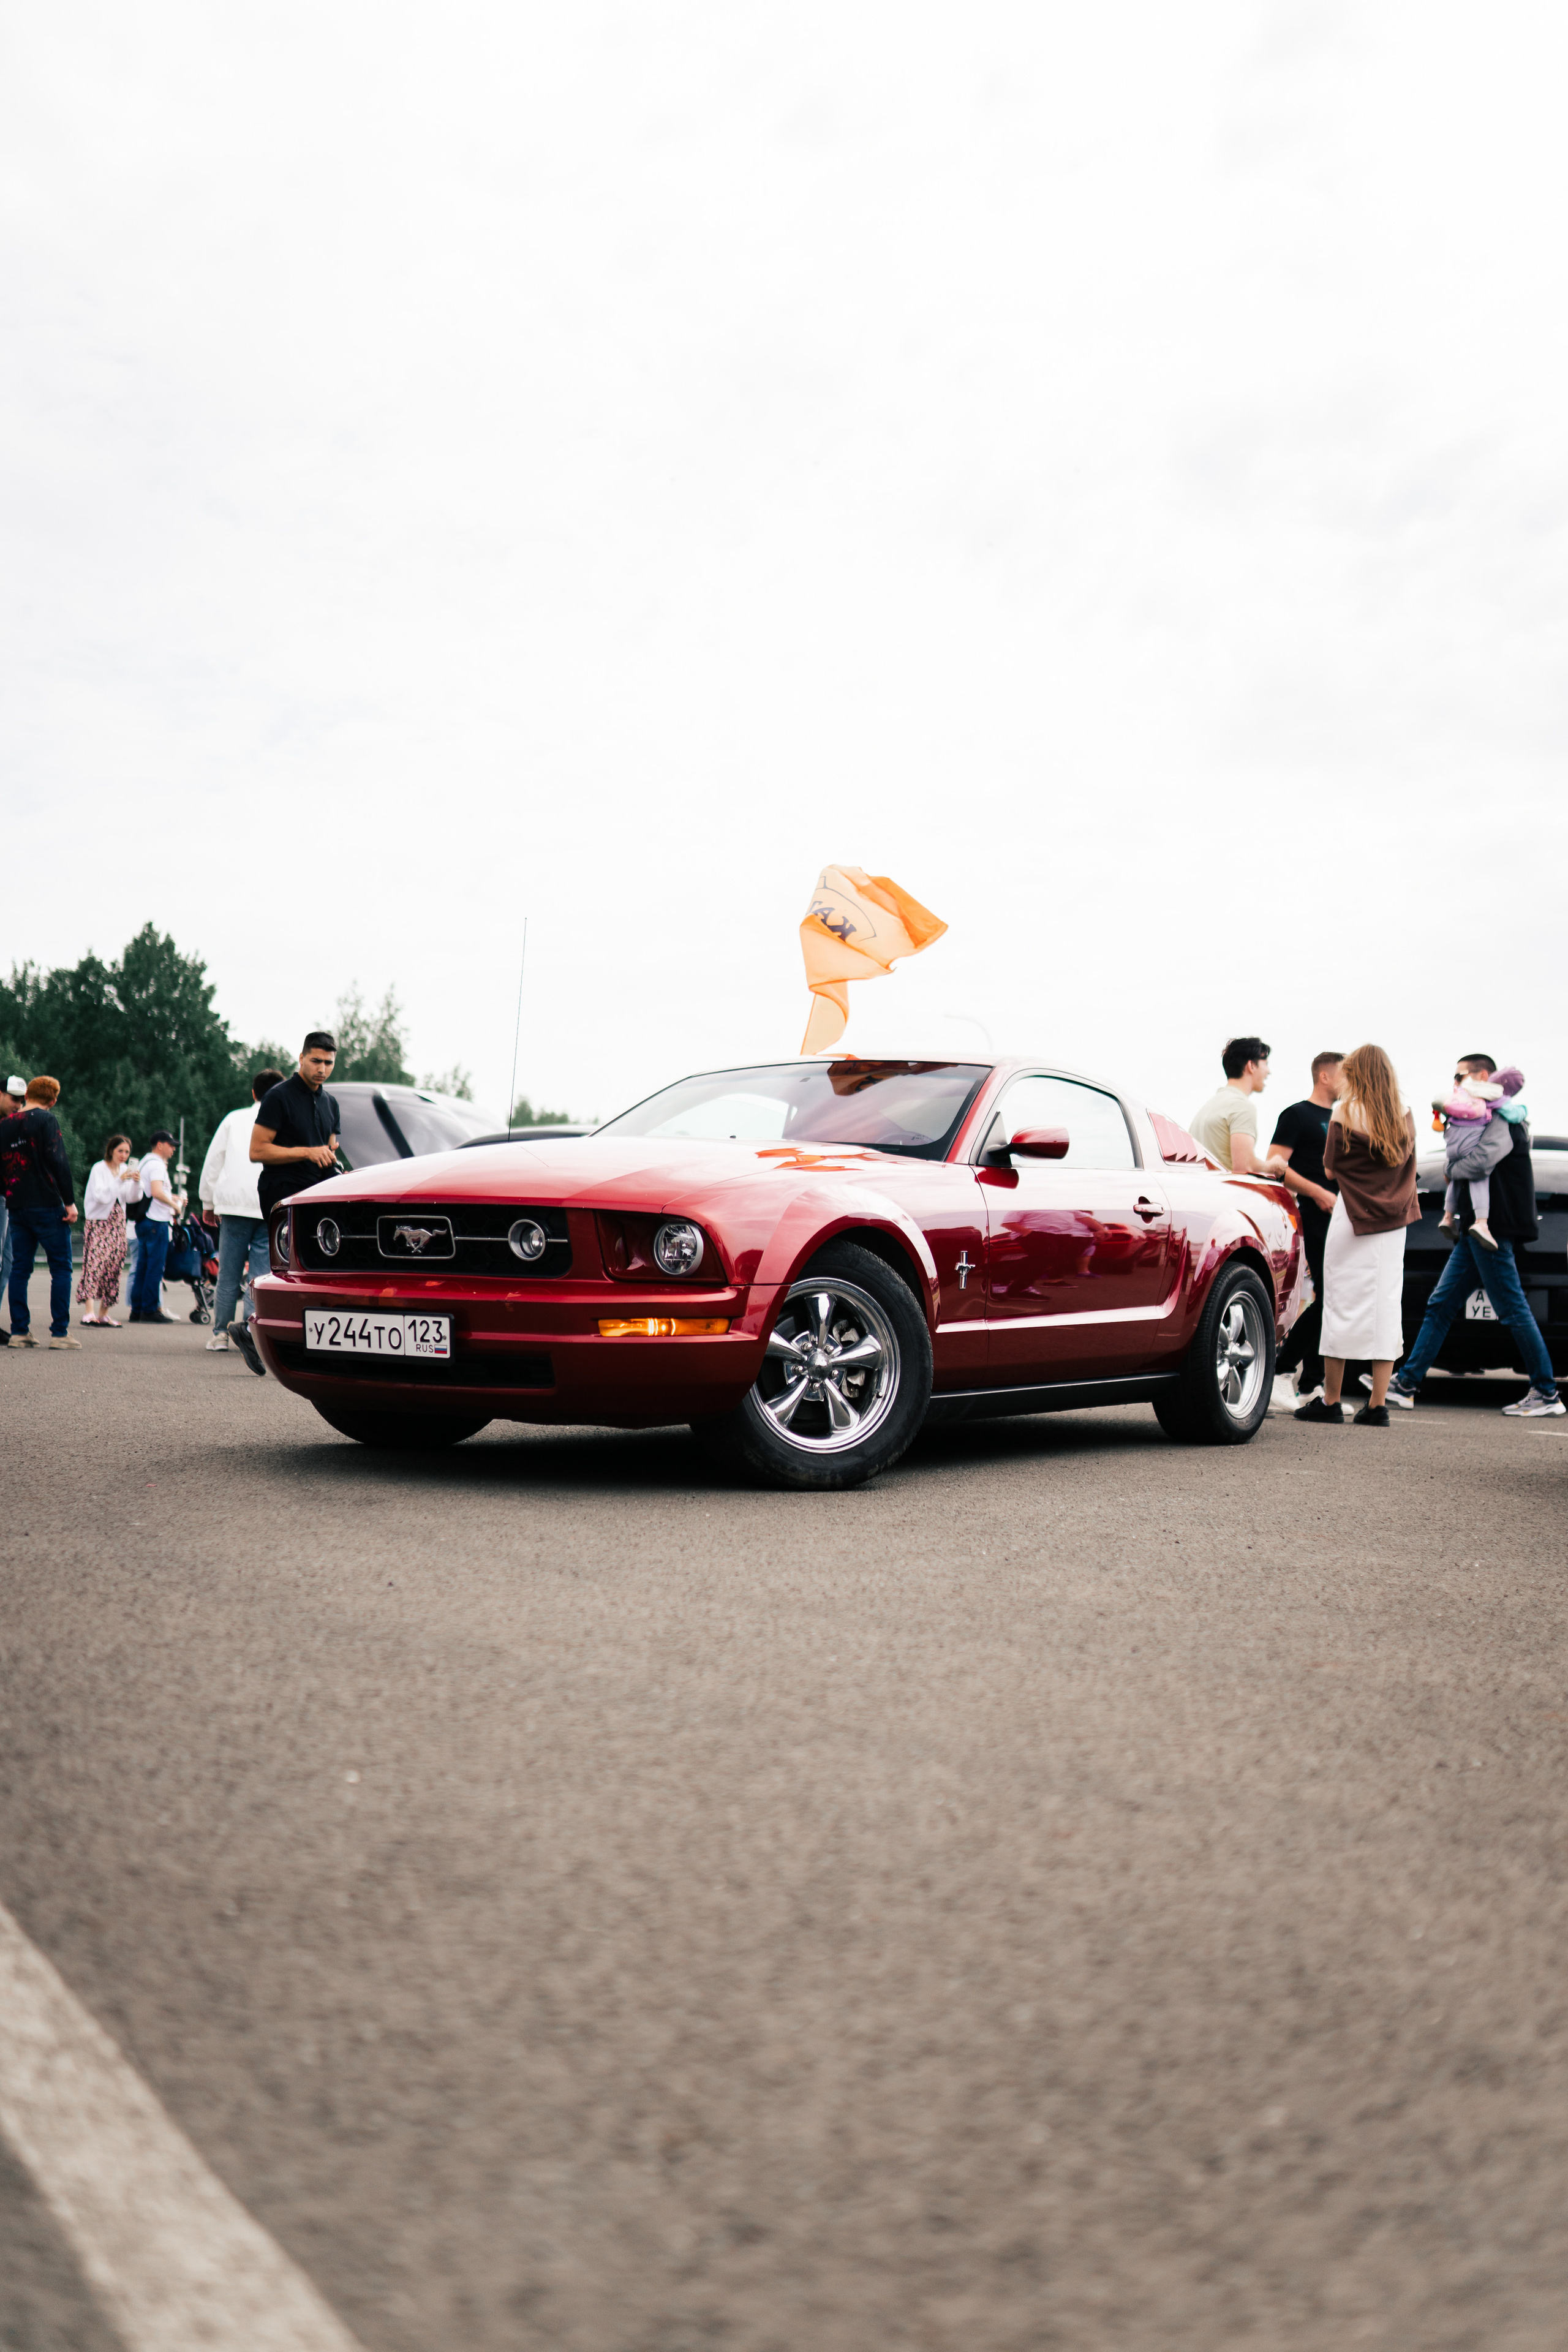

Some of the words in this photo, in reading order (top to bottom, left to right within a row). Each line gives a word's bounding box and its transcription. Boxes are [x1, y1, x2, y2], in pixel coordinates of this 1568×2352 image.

[314, 1317, 402, 1350] У244ТО
[408, 1319, 443, 1343] 123
[416, 1344, 434, 1353] RUS
